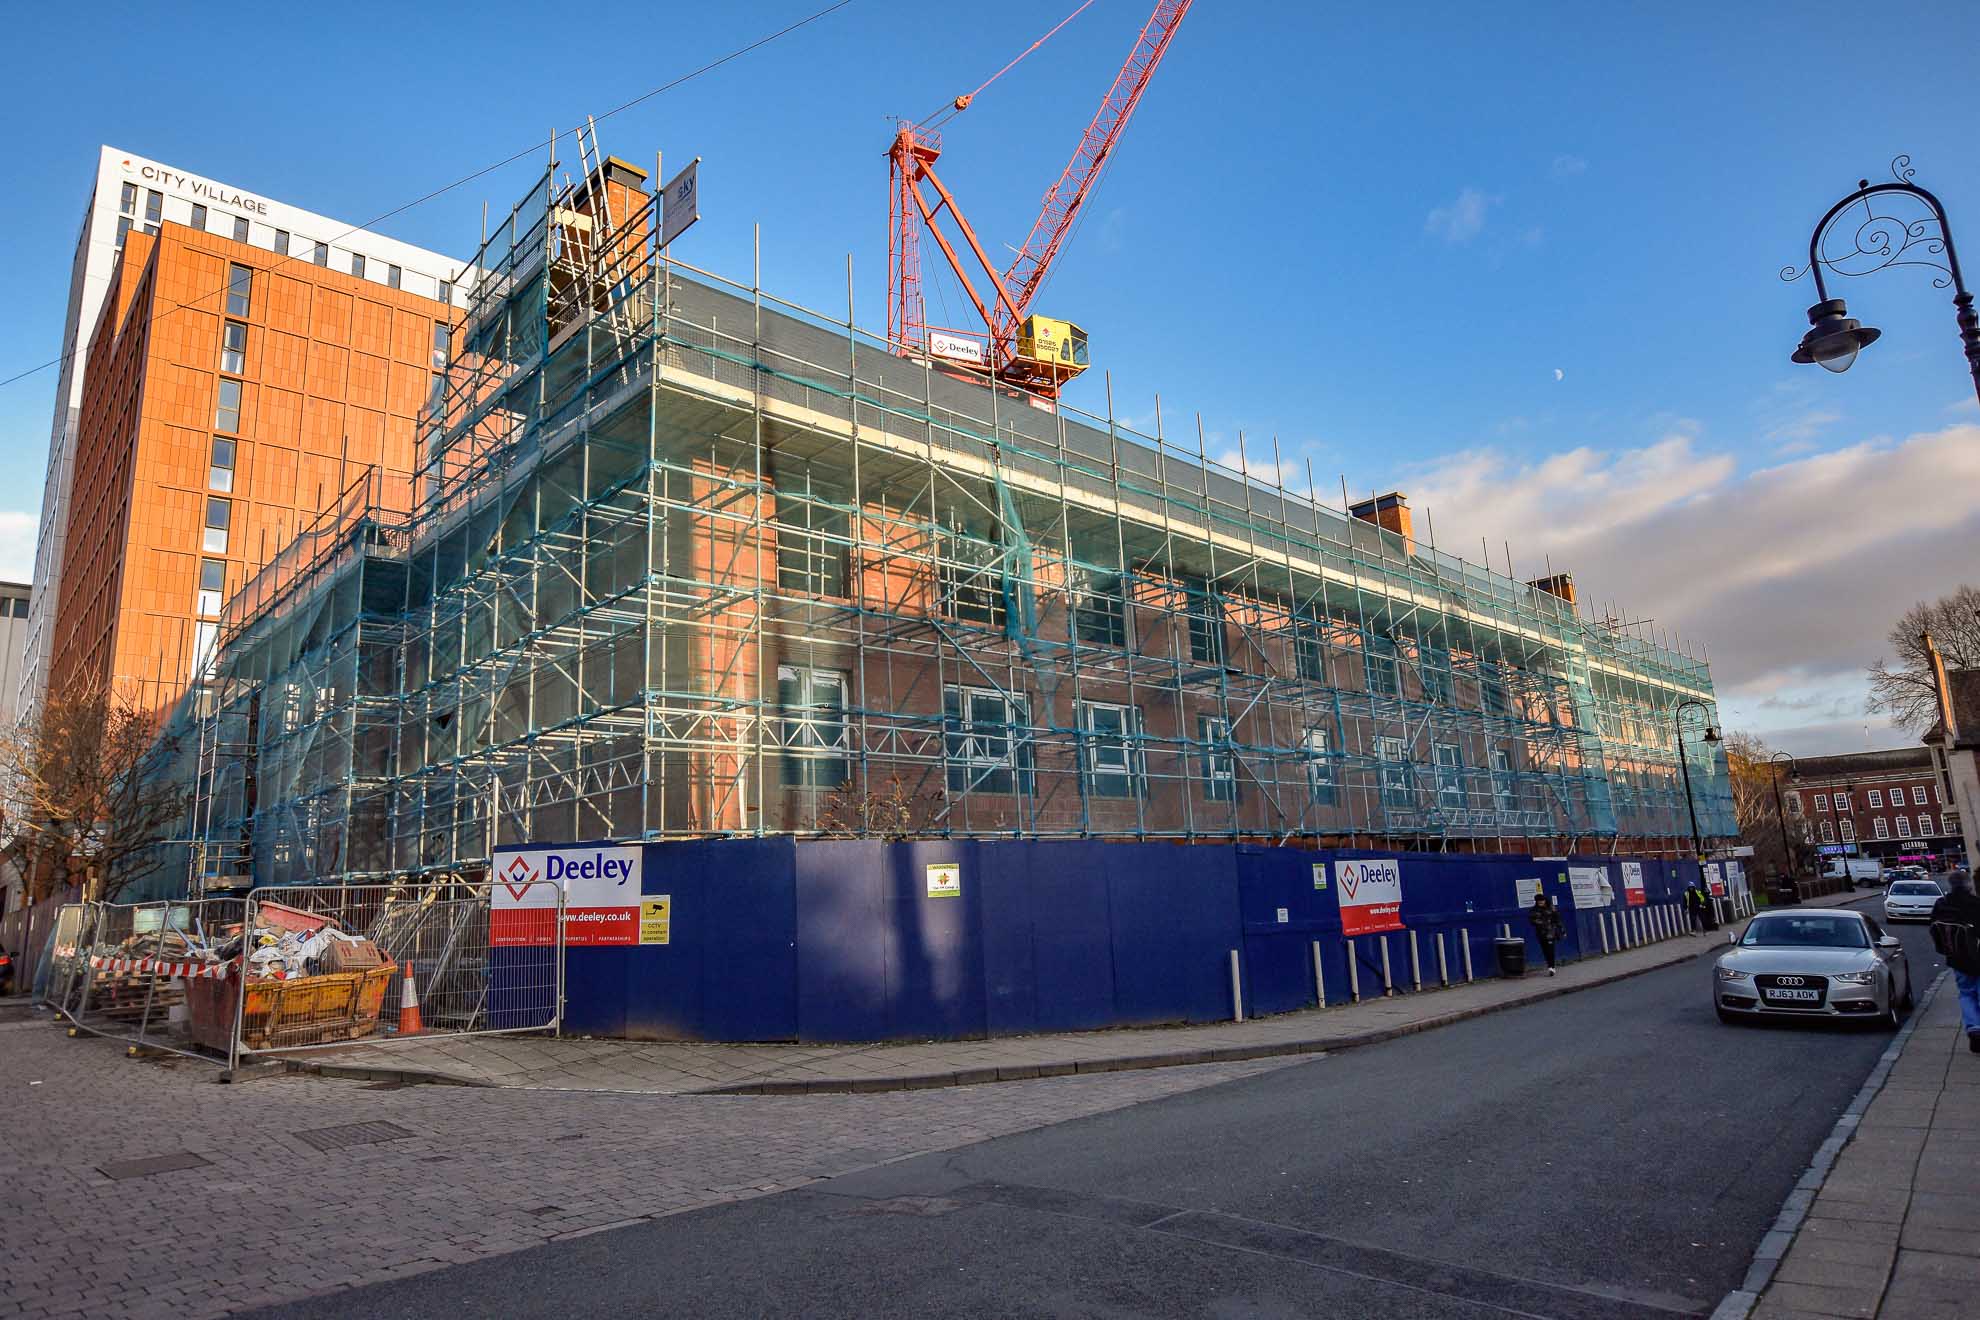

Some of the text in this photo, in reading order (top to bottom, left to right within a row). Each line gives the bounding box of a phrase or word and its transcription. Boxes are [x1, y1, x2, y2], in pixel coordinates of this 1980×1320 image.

[141, 166, 268, 216] CITY VILLAGE
[949, 342, 979, 357] Deeley
[546, 853, 633, 885] Deeley
[1360, 863, 1397, 887] Deeley
[1769, 990, 1794, 999] RJ63
